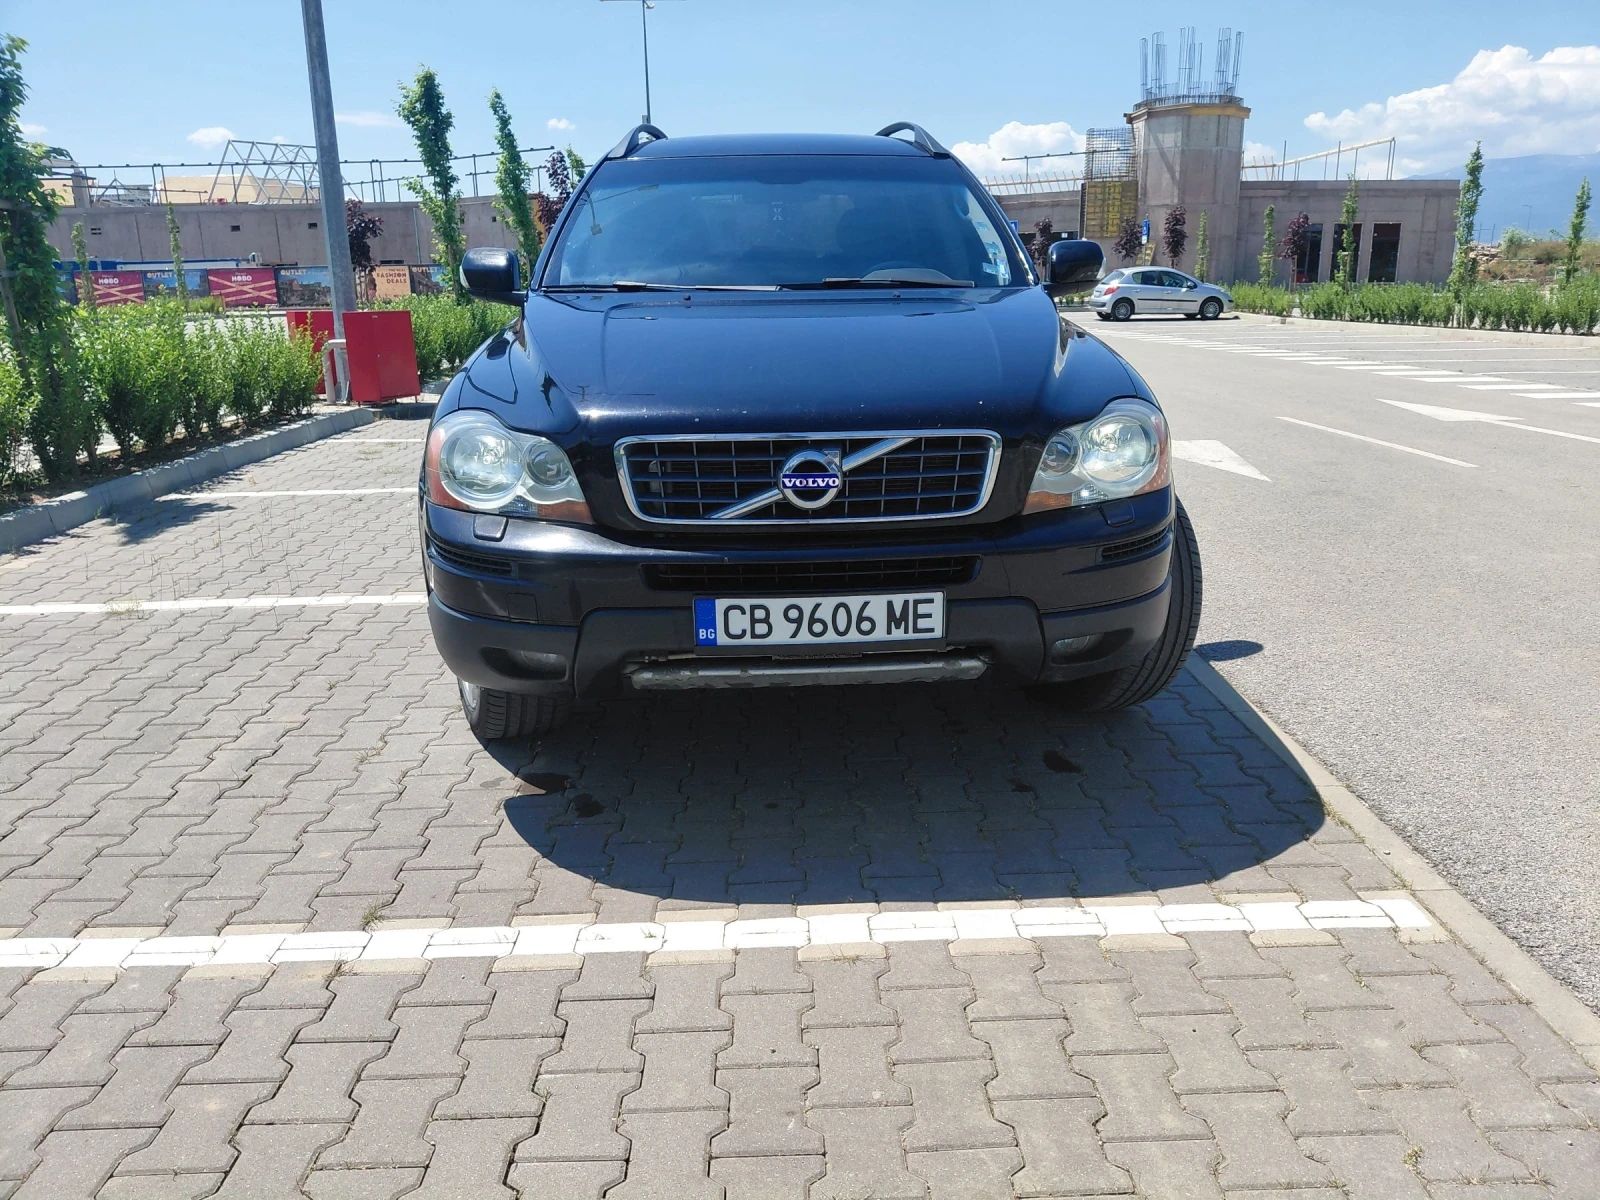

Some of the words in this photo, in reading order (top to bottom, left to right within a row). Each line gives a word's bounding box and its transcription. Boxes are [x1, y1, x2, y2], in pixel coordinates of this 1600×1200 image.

[781, 477, 840, 487] VOLVO
[723, 604, 774, 640] CB
[782, 601, 877, 639] 9606
[886, 598, 936, 636] ME
[699, 628, 716, 640] BG
